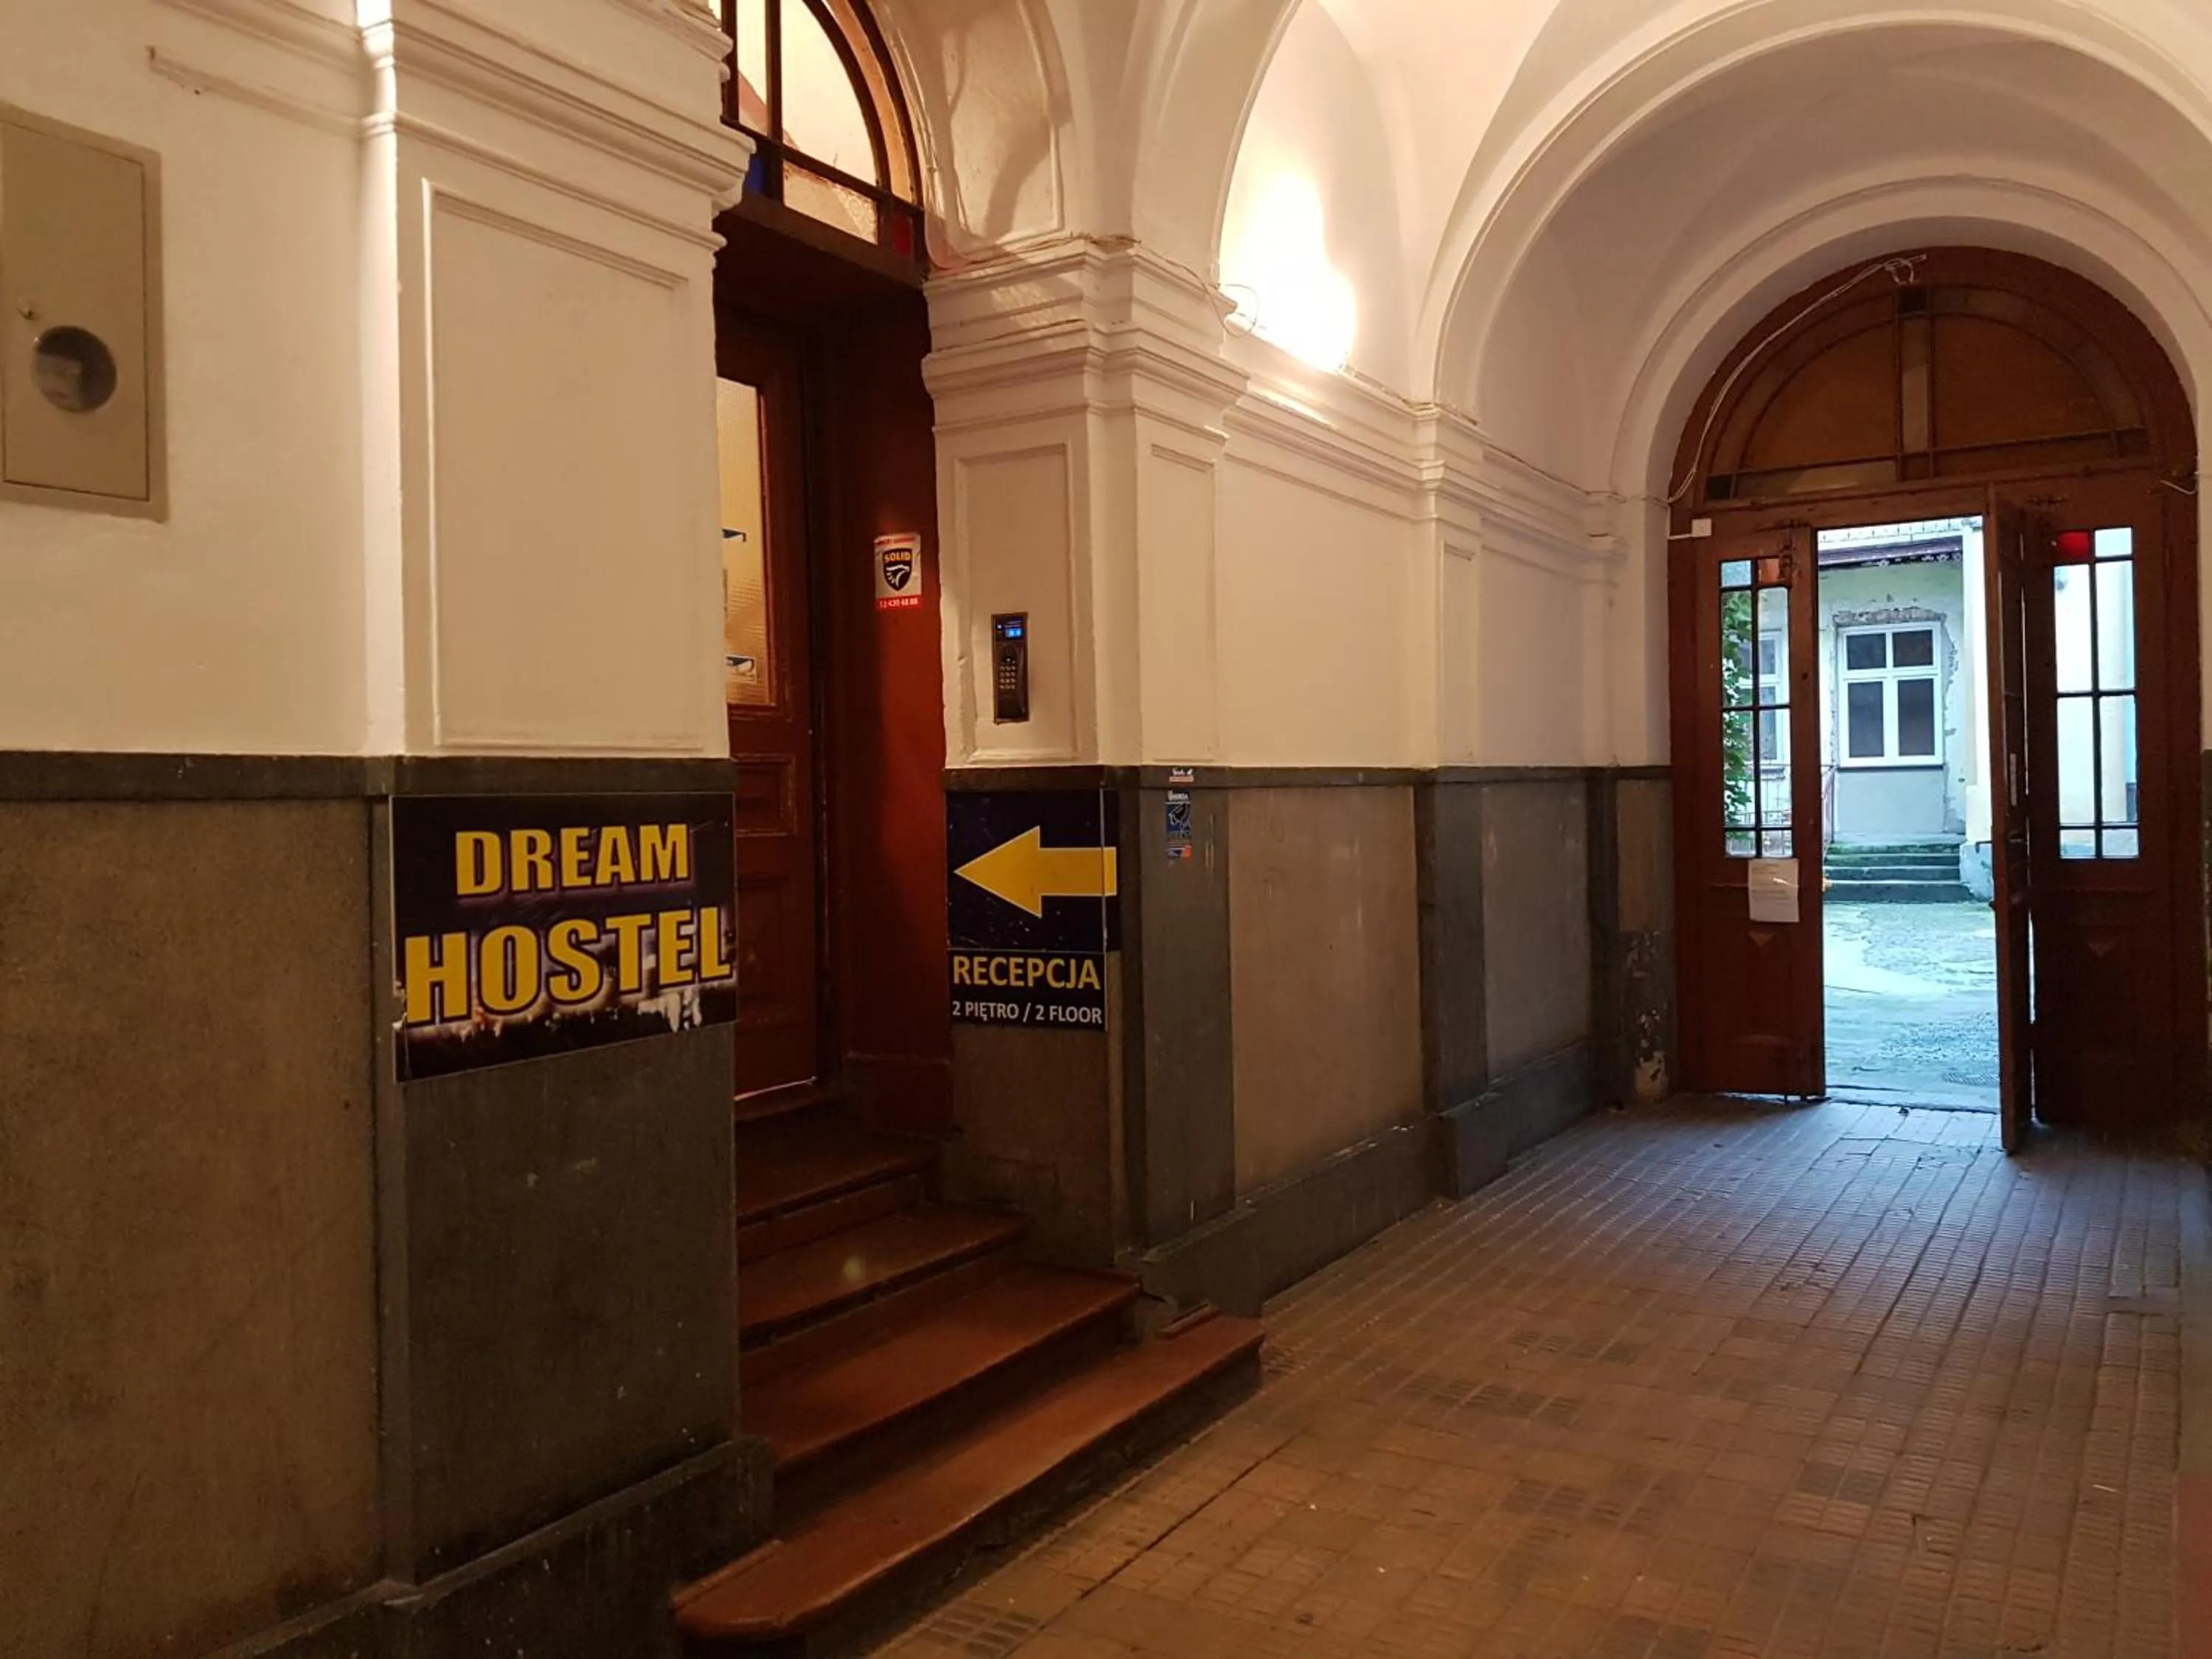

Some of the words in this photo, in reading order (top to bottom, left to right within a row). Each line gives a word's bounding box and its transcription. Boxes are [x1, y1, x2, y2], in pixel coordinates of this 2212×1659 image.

[884, 551, 911, 562] SOLID
[455, 823, 690, 897] DREAM
[404, 906, 733, 1025] HOSTEL
[953, 955, 1102, 990] RECEPCJA
[952, 1000, 961, 1017] 2
[964, 1001, 1020, 1022] PIĘTRO
[1034, 1004, 1046, 1021] 2
[1048, 1005, 1103, 1025] FLOOR
